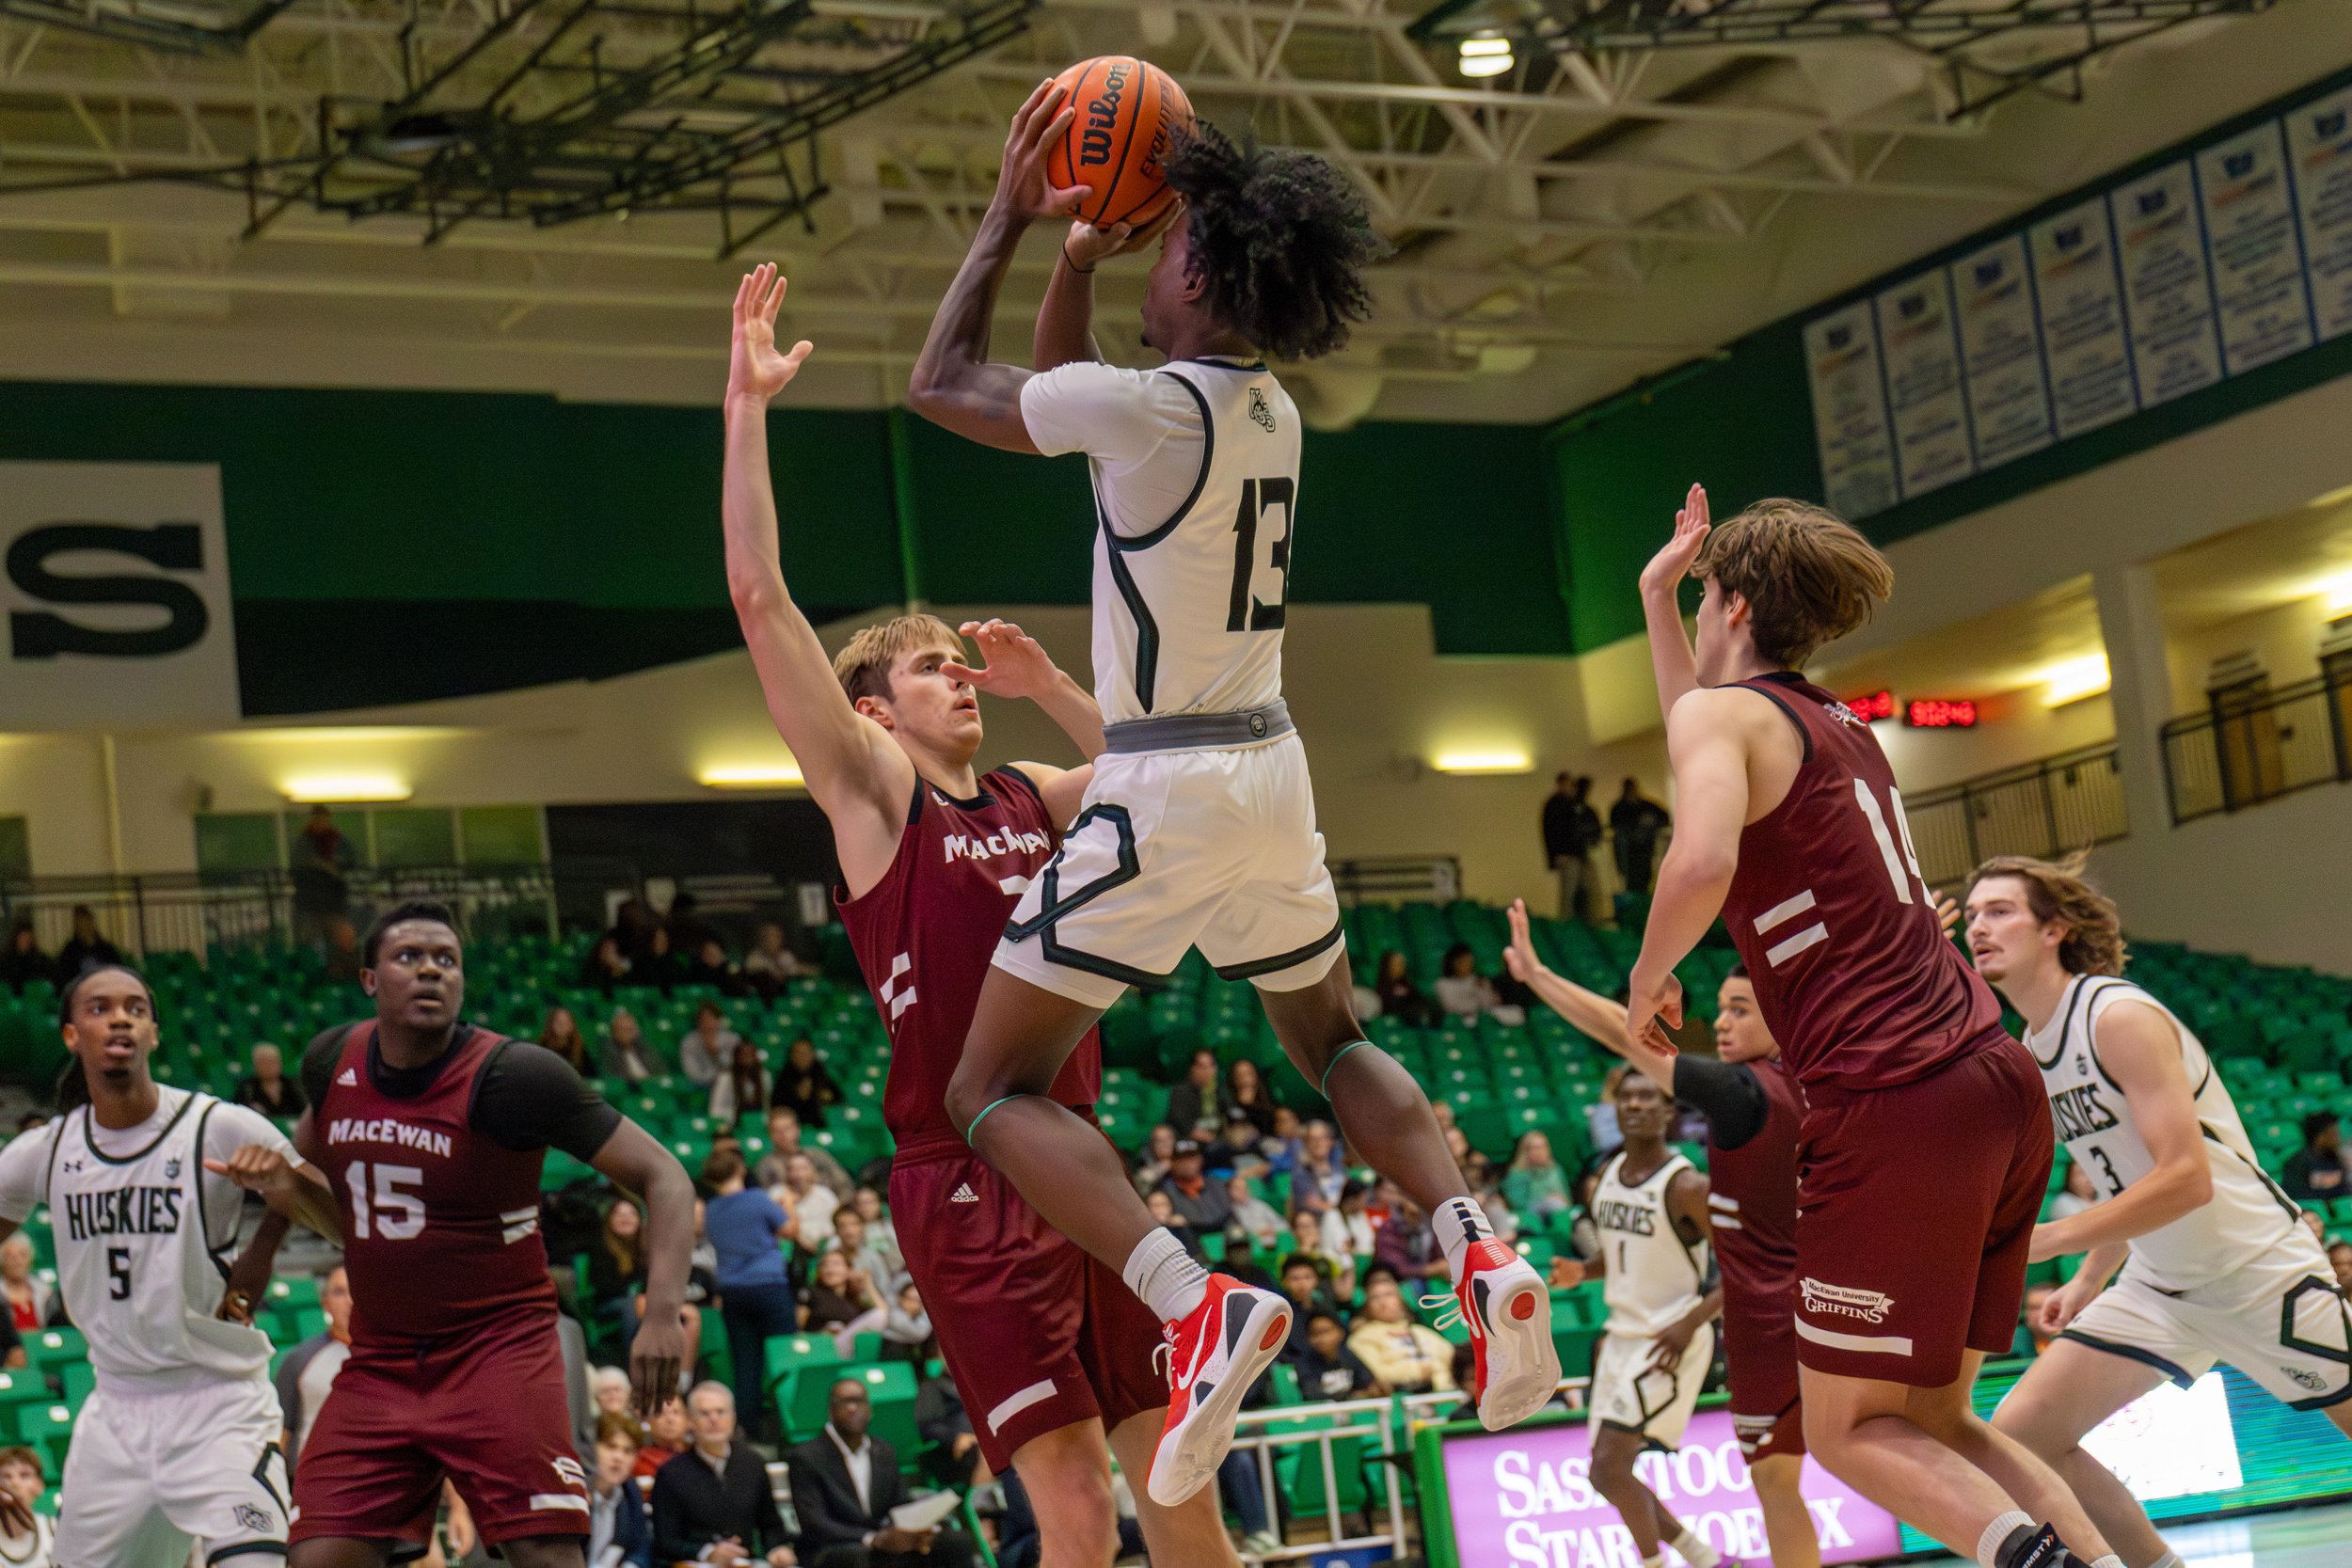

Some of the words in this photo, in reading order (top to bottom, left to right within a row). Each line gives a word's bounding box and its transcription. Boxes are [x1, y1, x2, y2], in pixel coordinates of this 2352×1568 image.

[1080, 64, 1131, 166] Wilson
[1226, 477, 1294, 632] 13
[6, 523, 210, 660] S
[328, 1117, 452, 1158] MACEWAN
[2089, 1145, 2126, 1197] 3
[64, 1185, 183, 1241] HUSKIES
[345, 1160, 426, 1241] 15
[951, 1195, 979, 1203] adidas
[107, 1247, 132, 1301] 5
[1808, 1281, 1840, 1296] MacEwan
[1841, 1291, 1880, 1304] University
[1805, 1297, 1883, 1323] GRIFFINS
